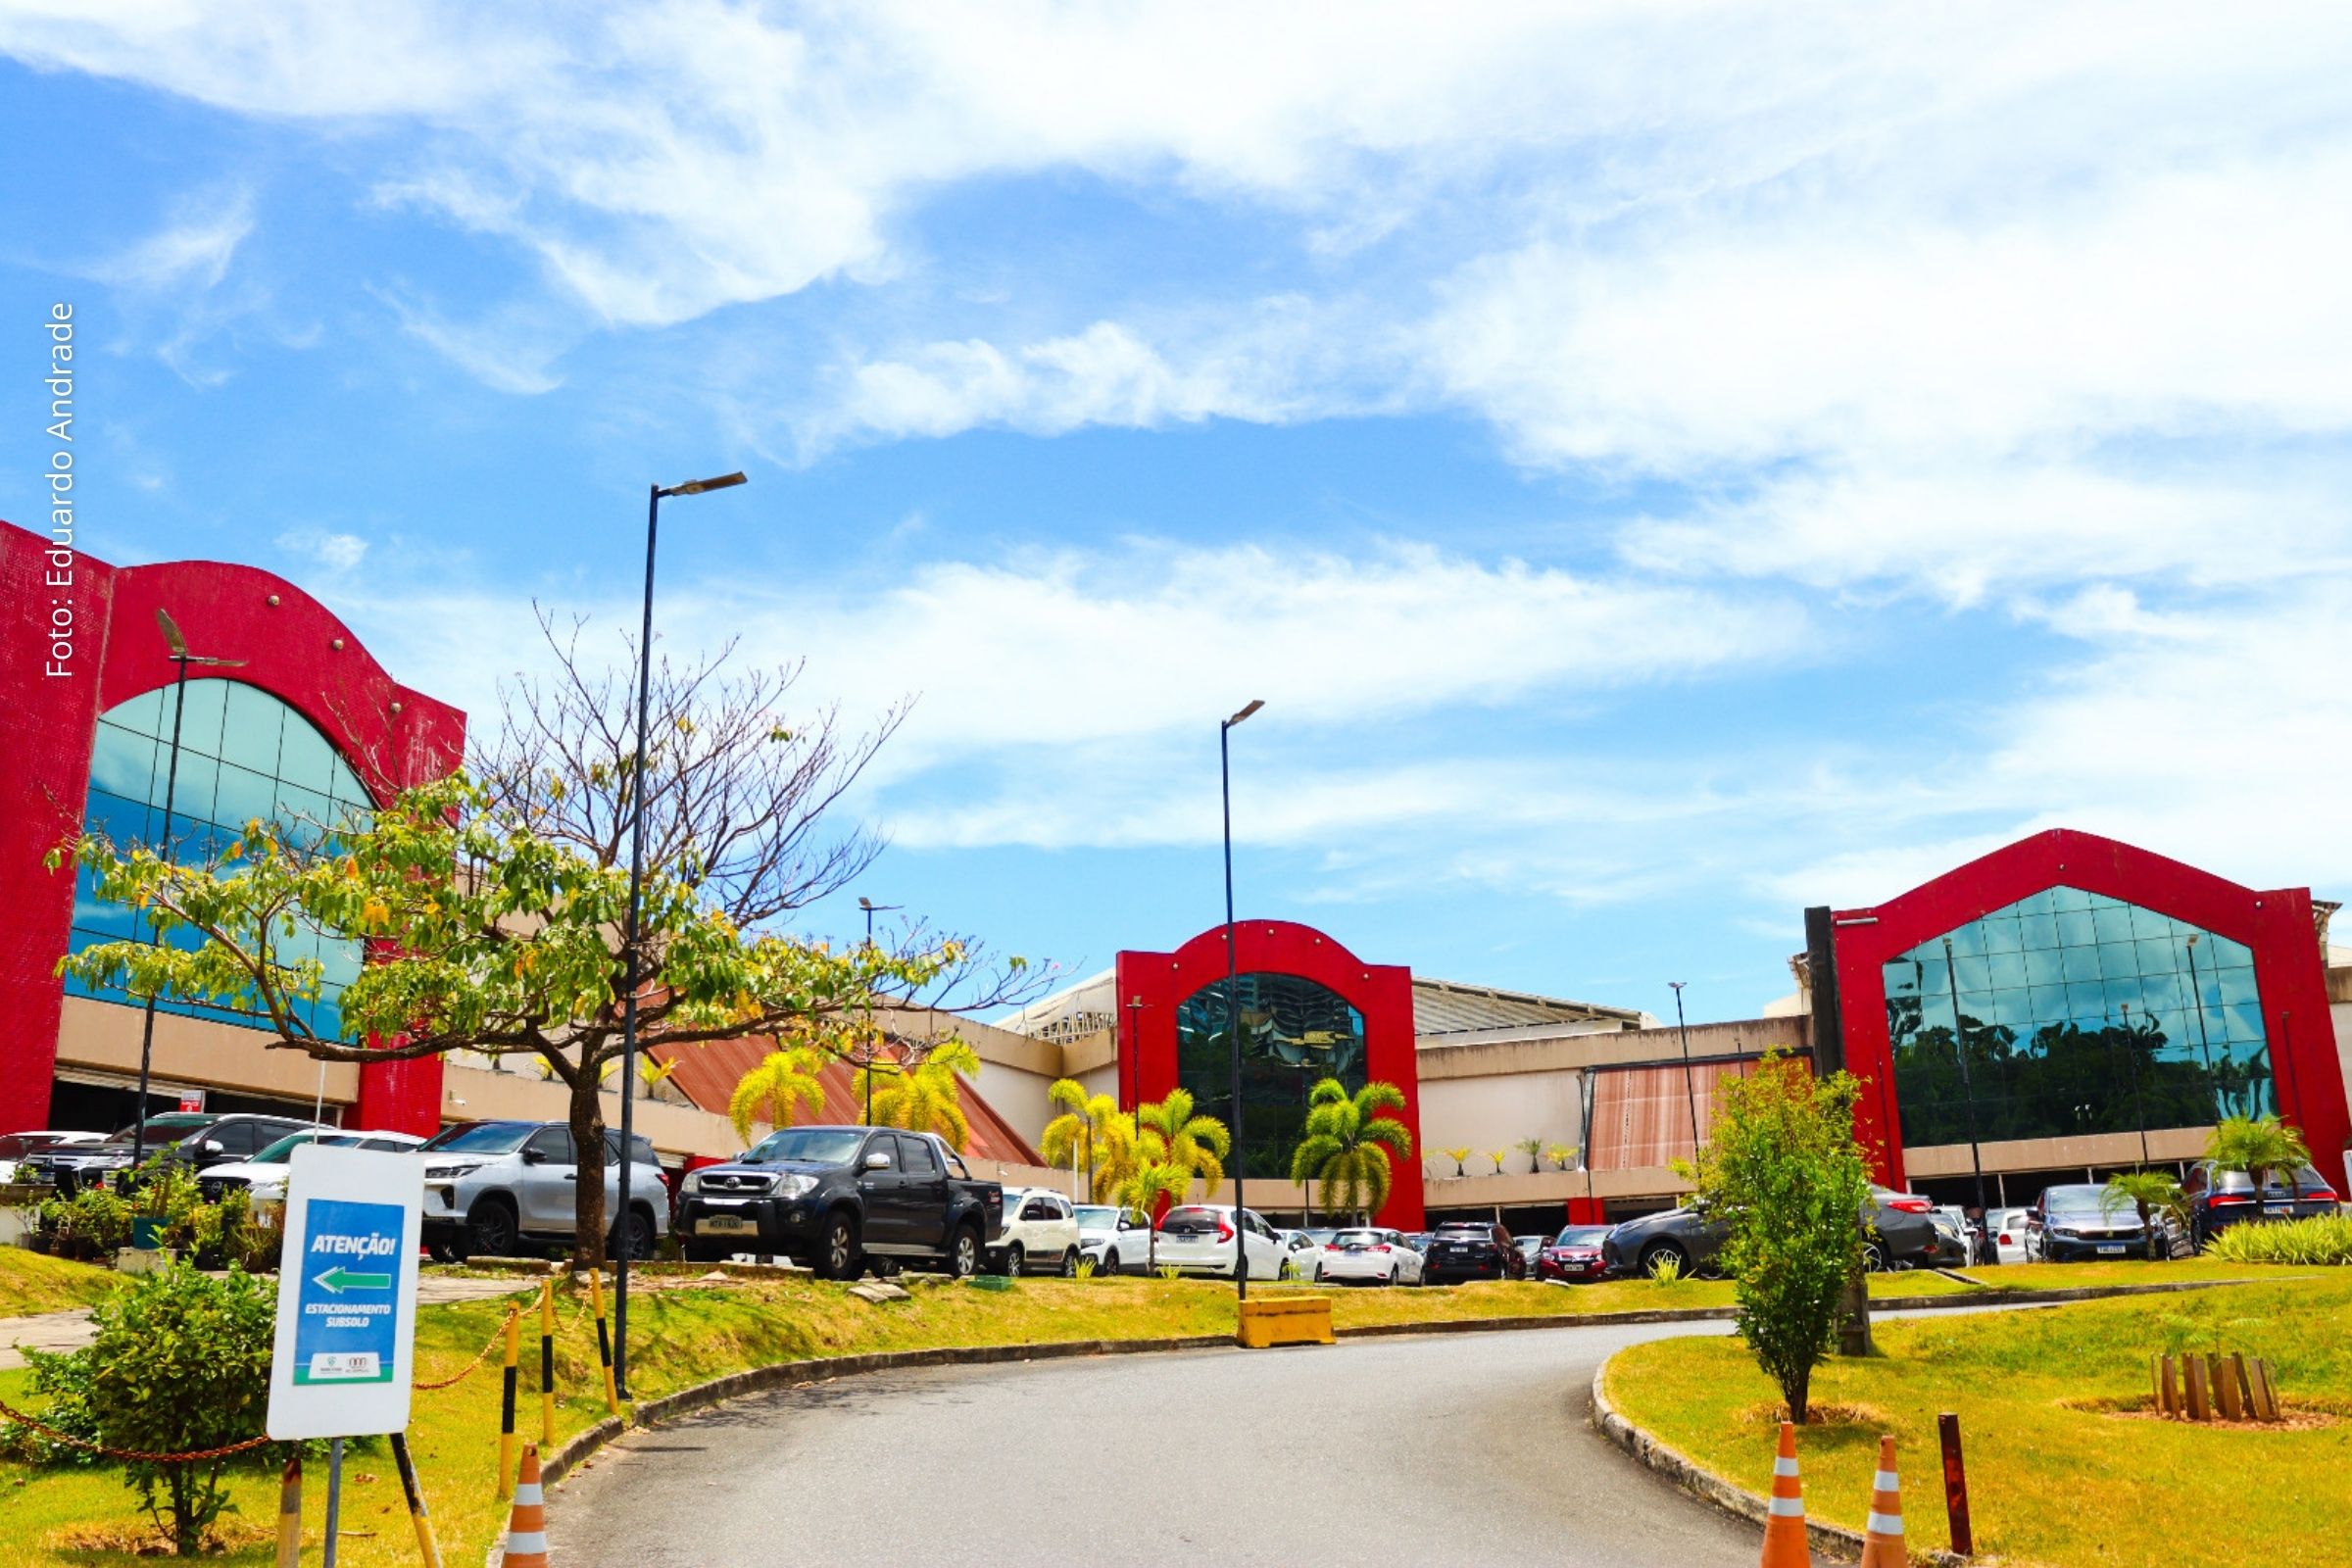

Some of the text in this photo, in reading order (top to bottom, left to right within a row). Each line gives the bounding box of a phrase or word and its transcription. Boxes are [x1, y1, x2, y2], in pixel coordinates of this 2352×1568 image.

[311, 1233, 395, 1260] ATENÇÃO!
[305, 1303, 390, 1314] ESTACIONAMENTO
[325, 1317, 369, 1327] SUBSOLO
